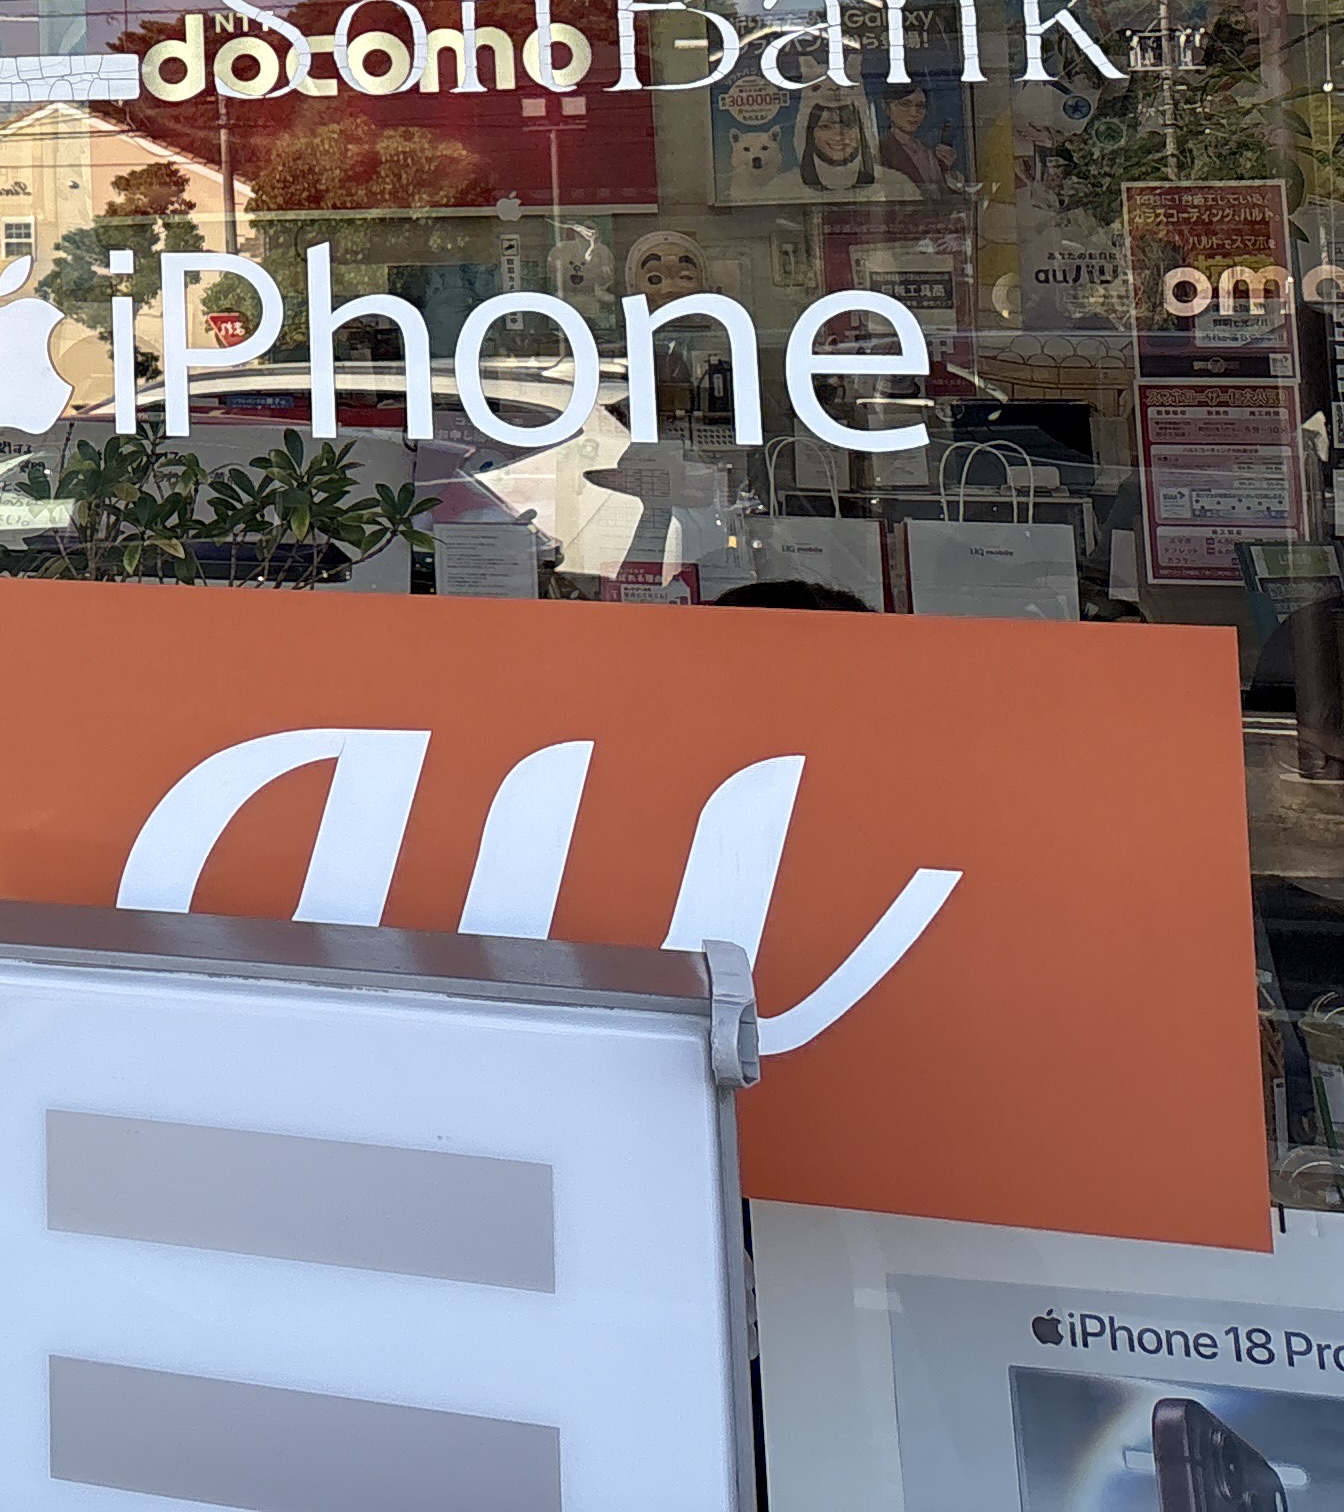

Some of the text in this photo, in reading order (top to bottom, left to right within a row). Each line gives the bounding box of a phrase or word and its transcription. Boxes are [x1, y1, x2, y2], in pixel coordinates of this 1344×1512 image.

[141, 14, 593, 103] docomo
[843, 8, 934, 34] Galxy
[109, 240, 932, 453] iPhone
[114, 726, 963, 1057] au
[1068, 1311, 1220, 1361] iPhone
[1223, 1325, 1276, 1366] 18
